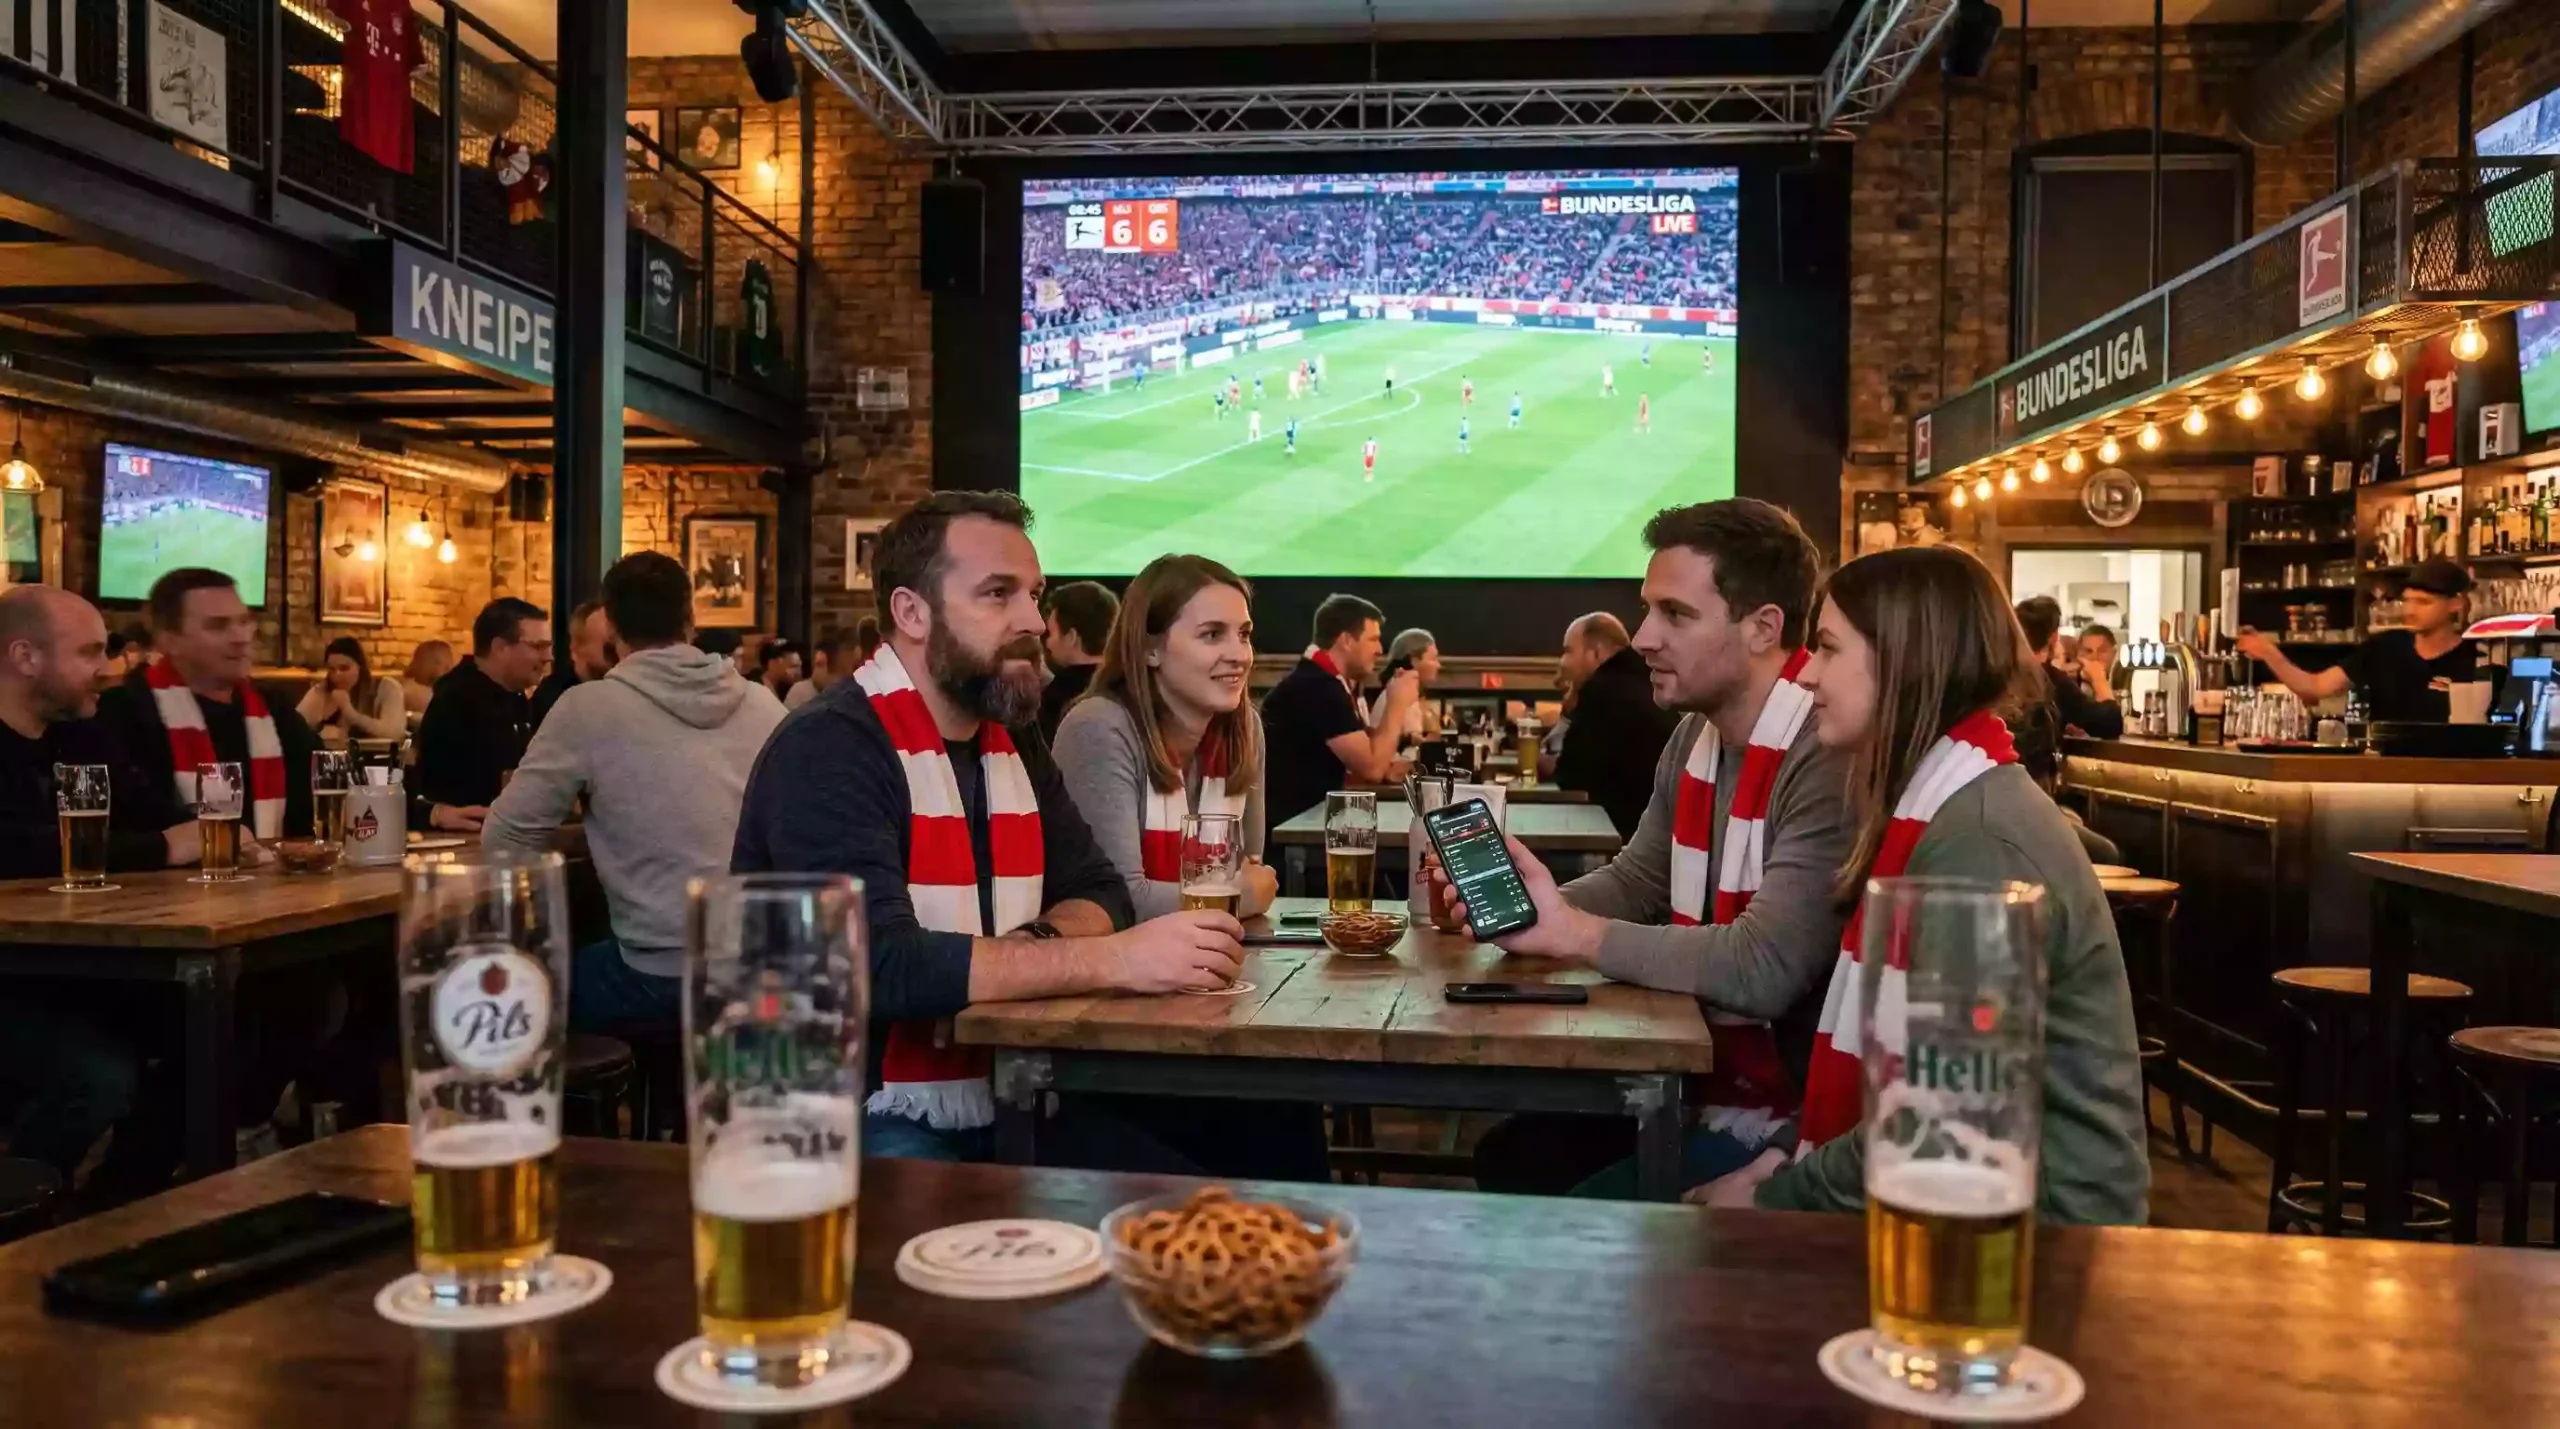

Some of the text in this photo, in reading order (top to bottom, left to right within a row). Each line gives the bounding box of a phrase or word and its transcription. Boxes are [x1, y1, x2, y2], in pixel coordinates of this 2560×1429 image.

[1560, 195, 1695, 214] BUNDESLIGA
[1112, 219, 1132, 244] 6
[1148, 219, 1168, 244] 6
[1655, 215, 1693, 232] LIVE
[412, 265, 553, 374] KNEIPE
[2016, 325, 2148, 422] BUNDESLIGA
[452, 1000, 532, 1049] Pils
